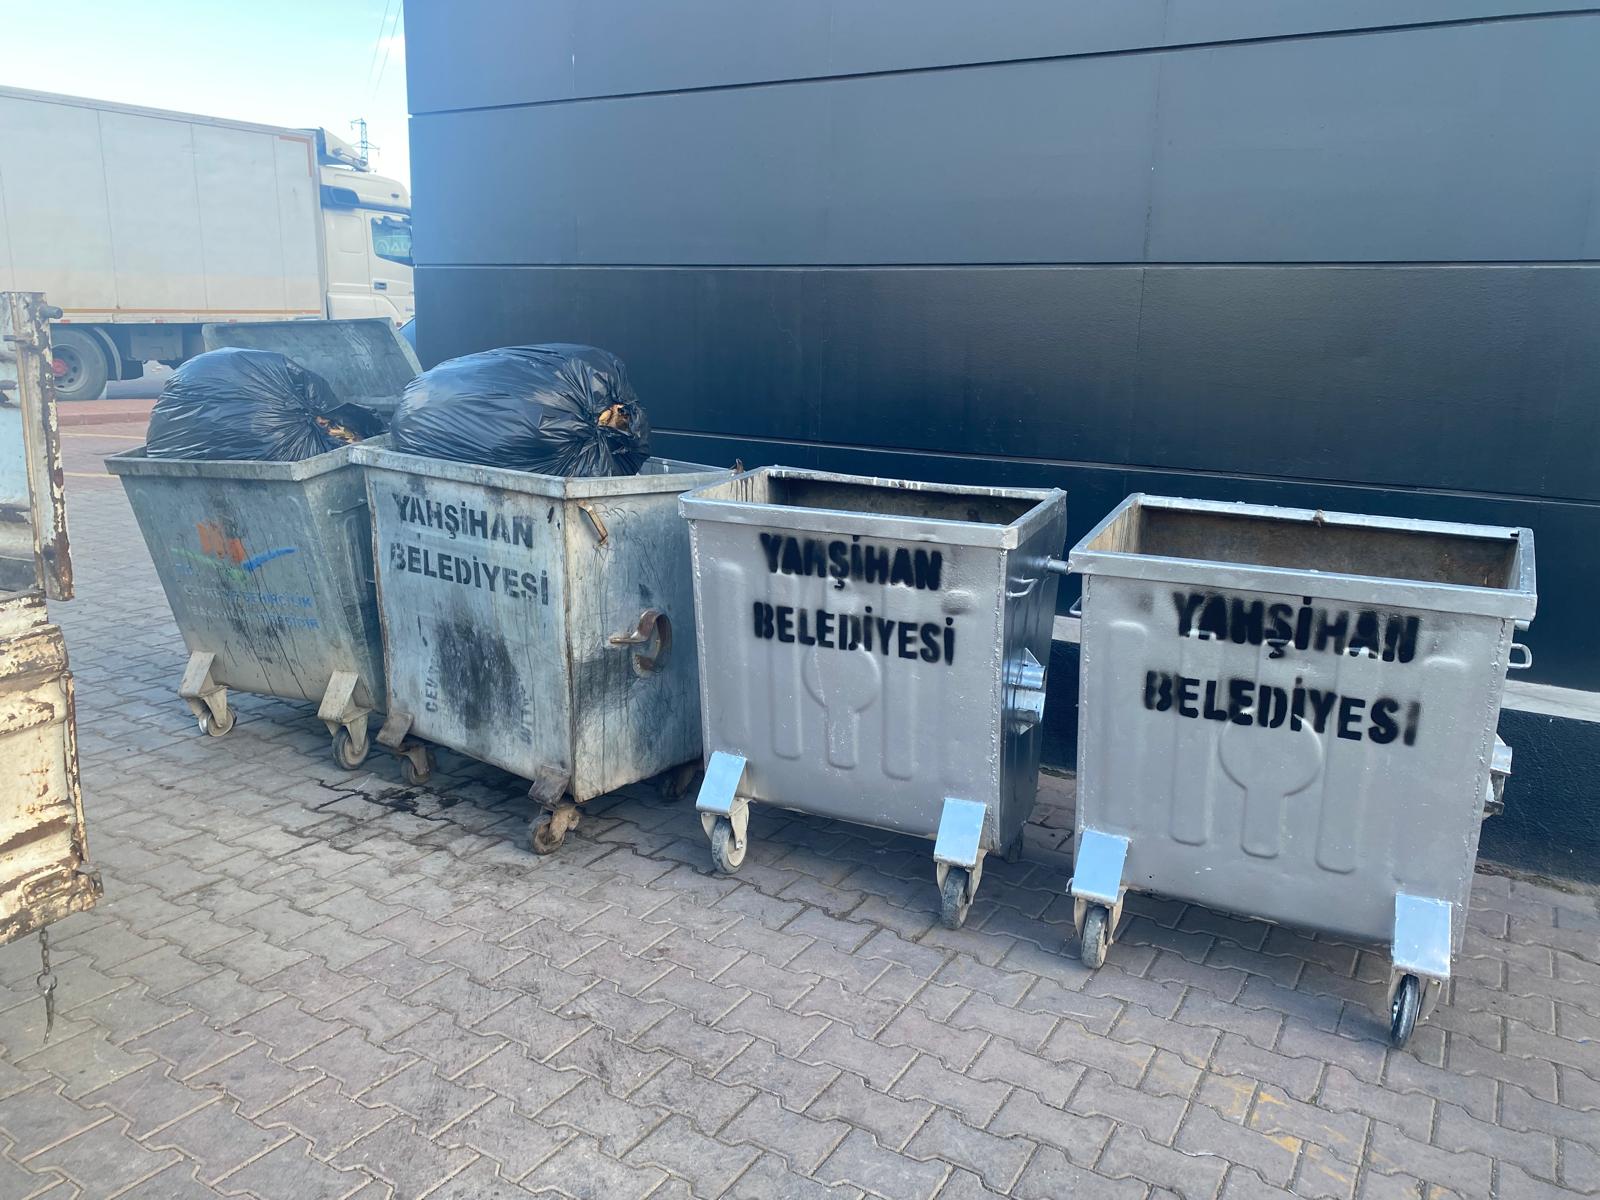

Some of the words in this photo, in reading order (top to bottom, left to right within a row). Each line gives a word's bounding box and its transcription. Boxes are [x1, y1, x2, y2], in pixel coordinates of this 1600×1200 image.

[391, 492, 536, 549] YAHŞİHAN
[390, 542, 549, 606] BELEDİYESİ
[759, 532, 943, 591] YAHŞİHAN
[753, 601, 955, 666] BELEDİYESİ
[1172, 591, 1421, 663] YAHŞİHAN
